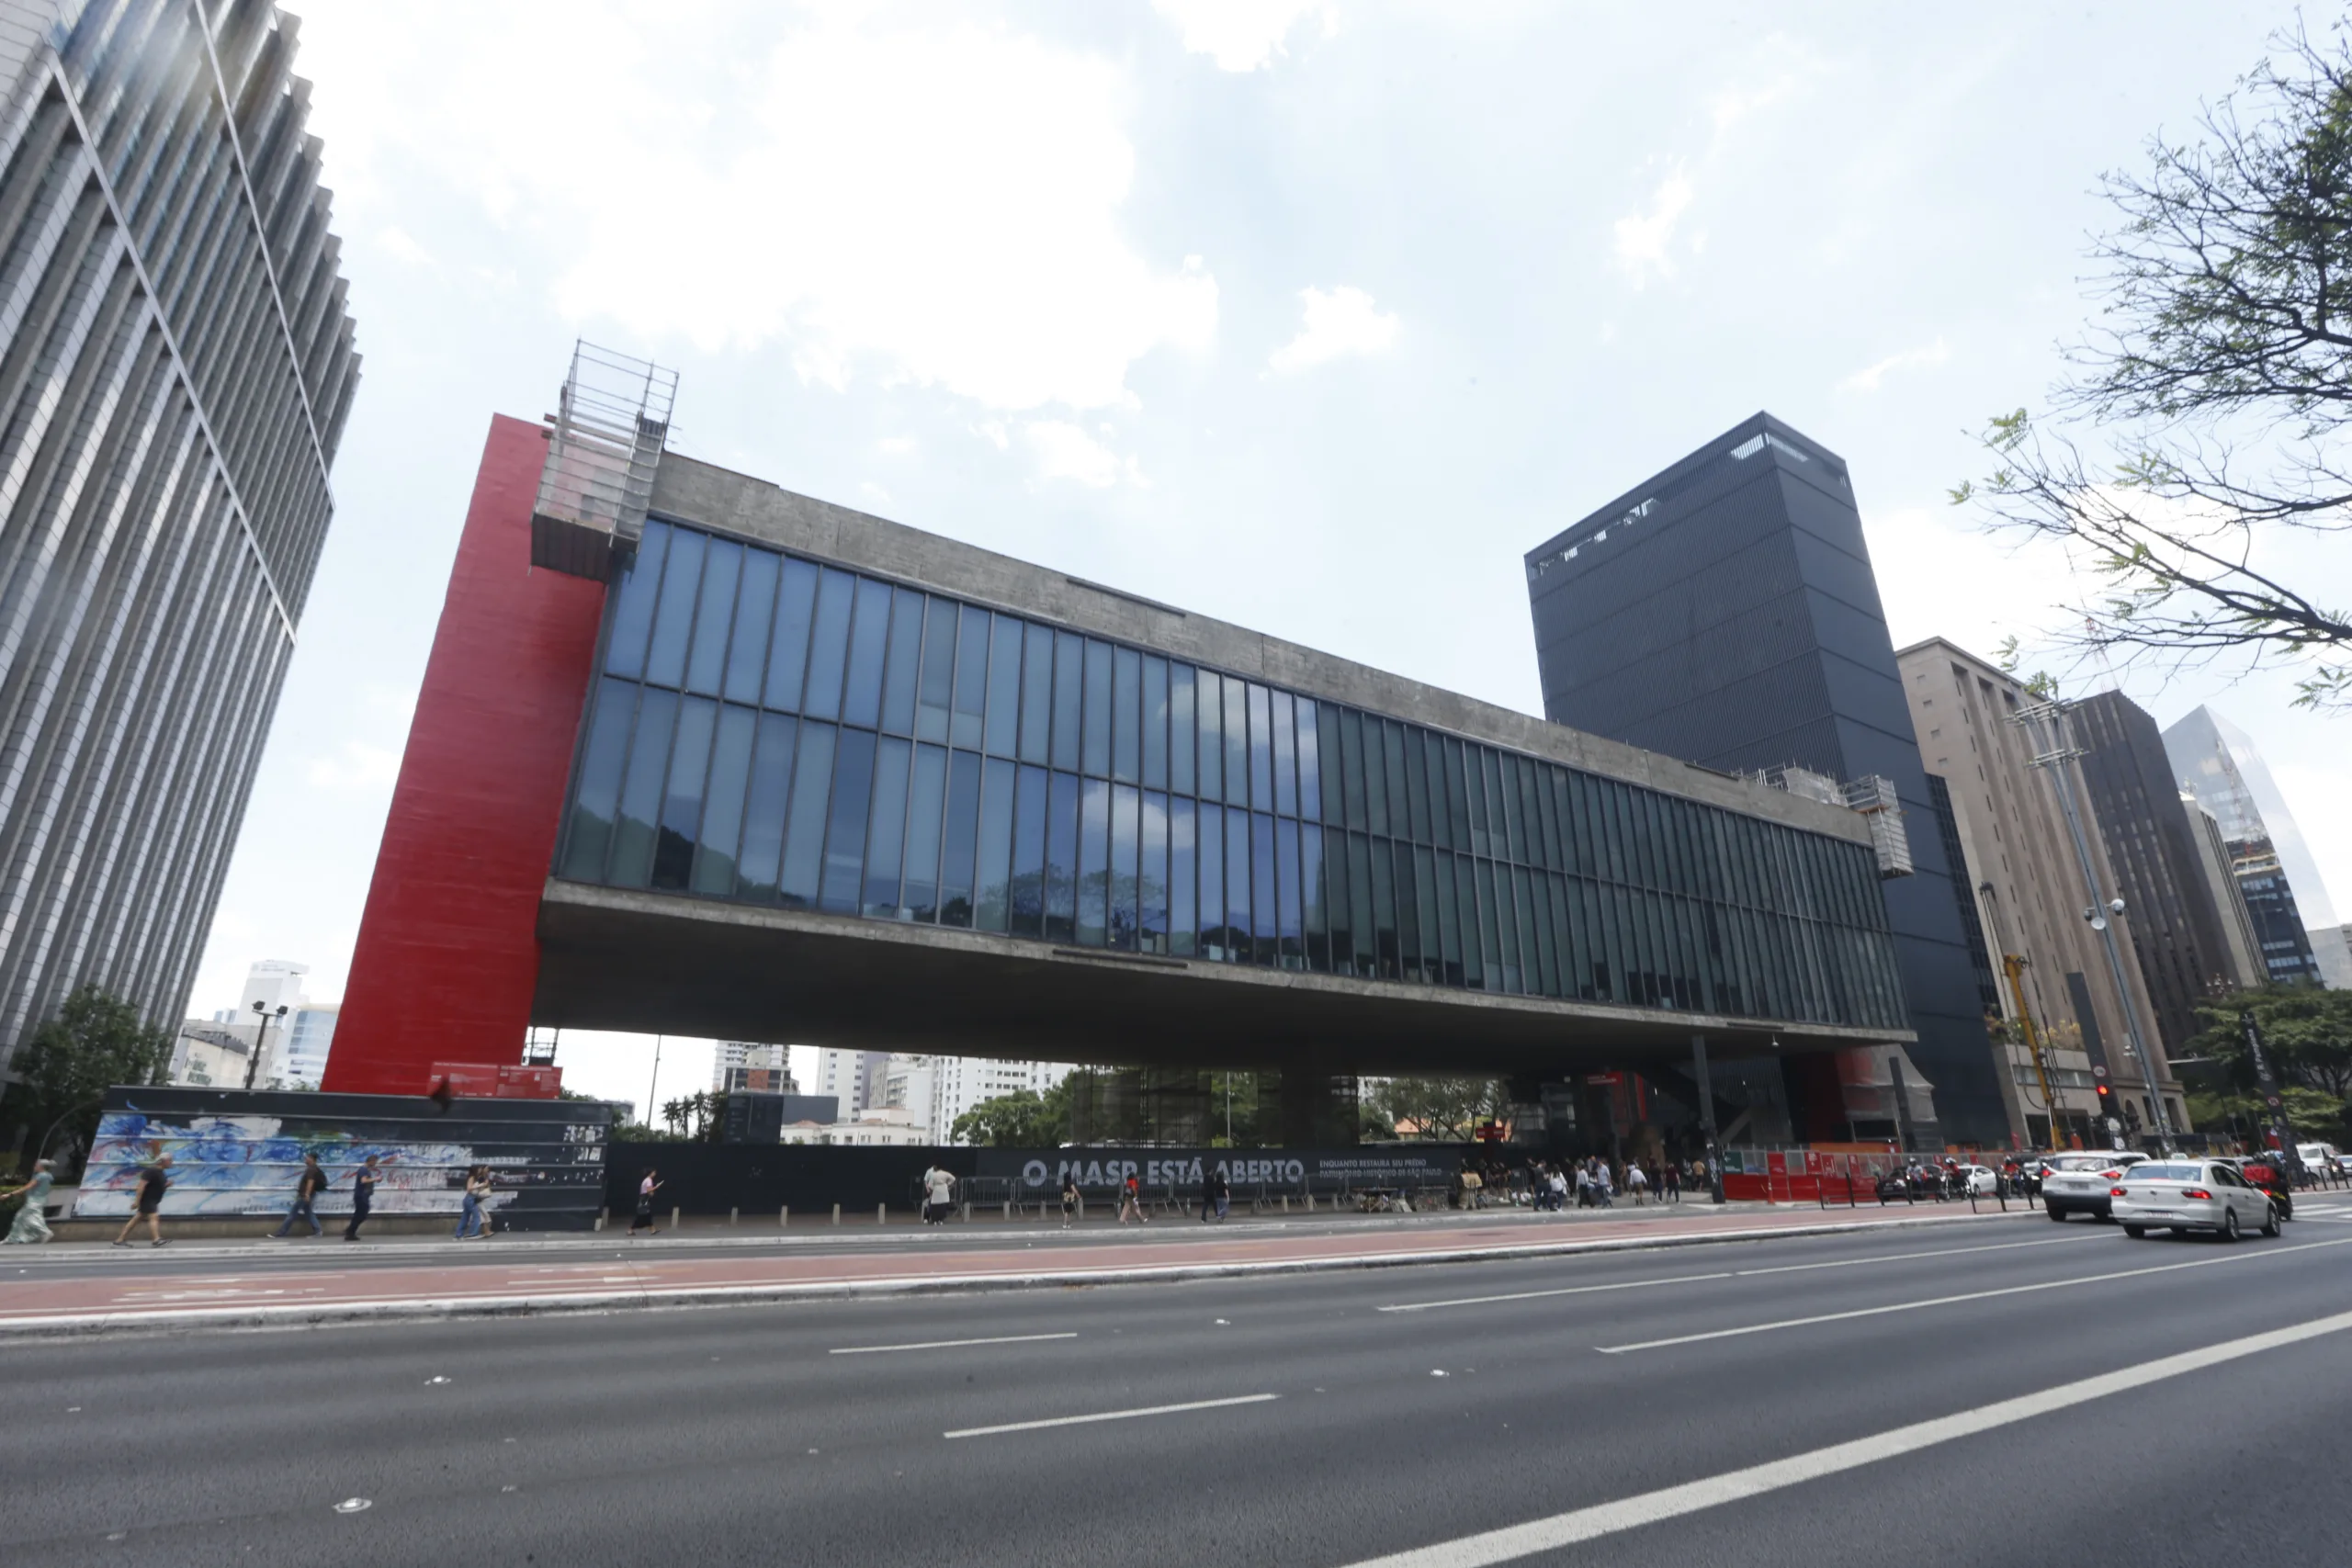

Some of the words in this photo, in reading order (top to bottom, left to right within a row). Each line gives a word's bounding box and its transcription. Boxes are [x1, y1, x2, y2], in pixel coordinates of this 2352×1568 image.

[1319, 1159, 1357, 1168] ENQUANTO
[1359, 1159, 1389, 1168] RESTAURA
[1392, 1159, 1403, 1168] SEU
[1405, 1158, 1427, 1167] PRÉDIO
[1023, 1159, 1047, 1187] O
[1057, 1160, 1137, 1186] MASP
[1216, 1159, 1304, 1183] ABERTO
[1397, 1168, 1406, 1177] DE
